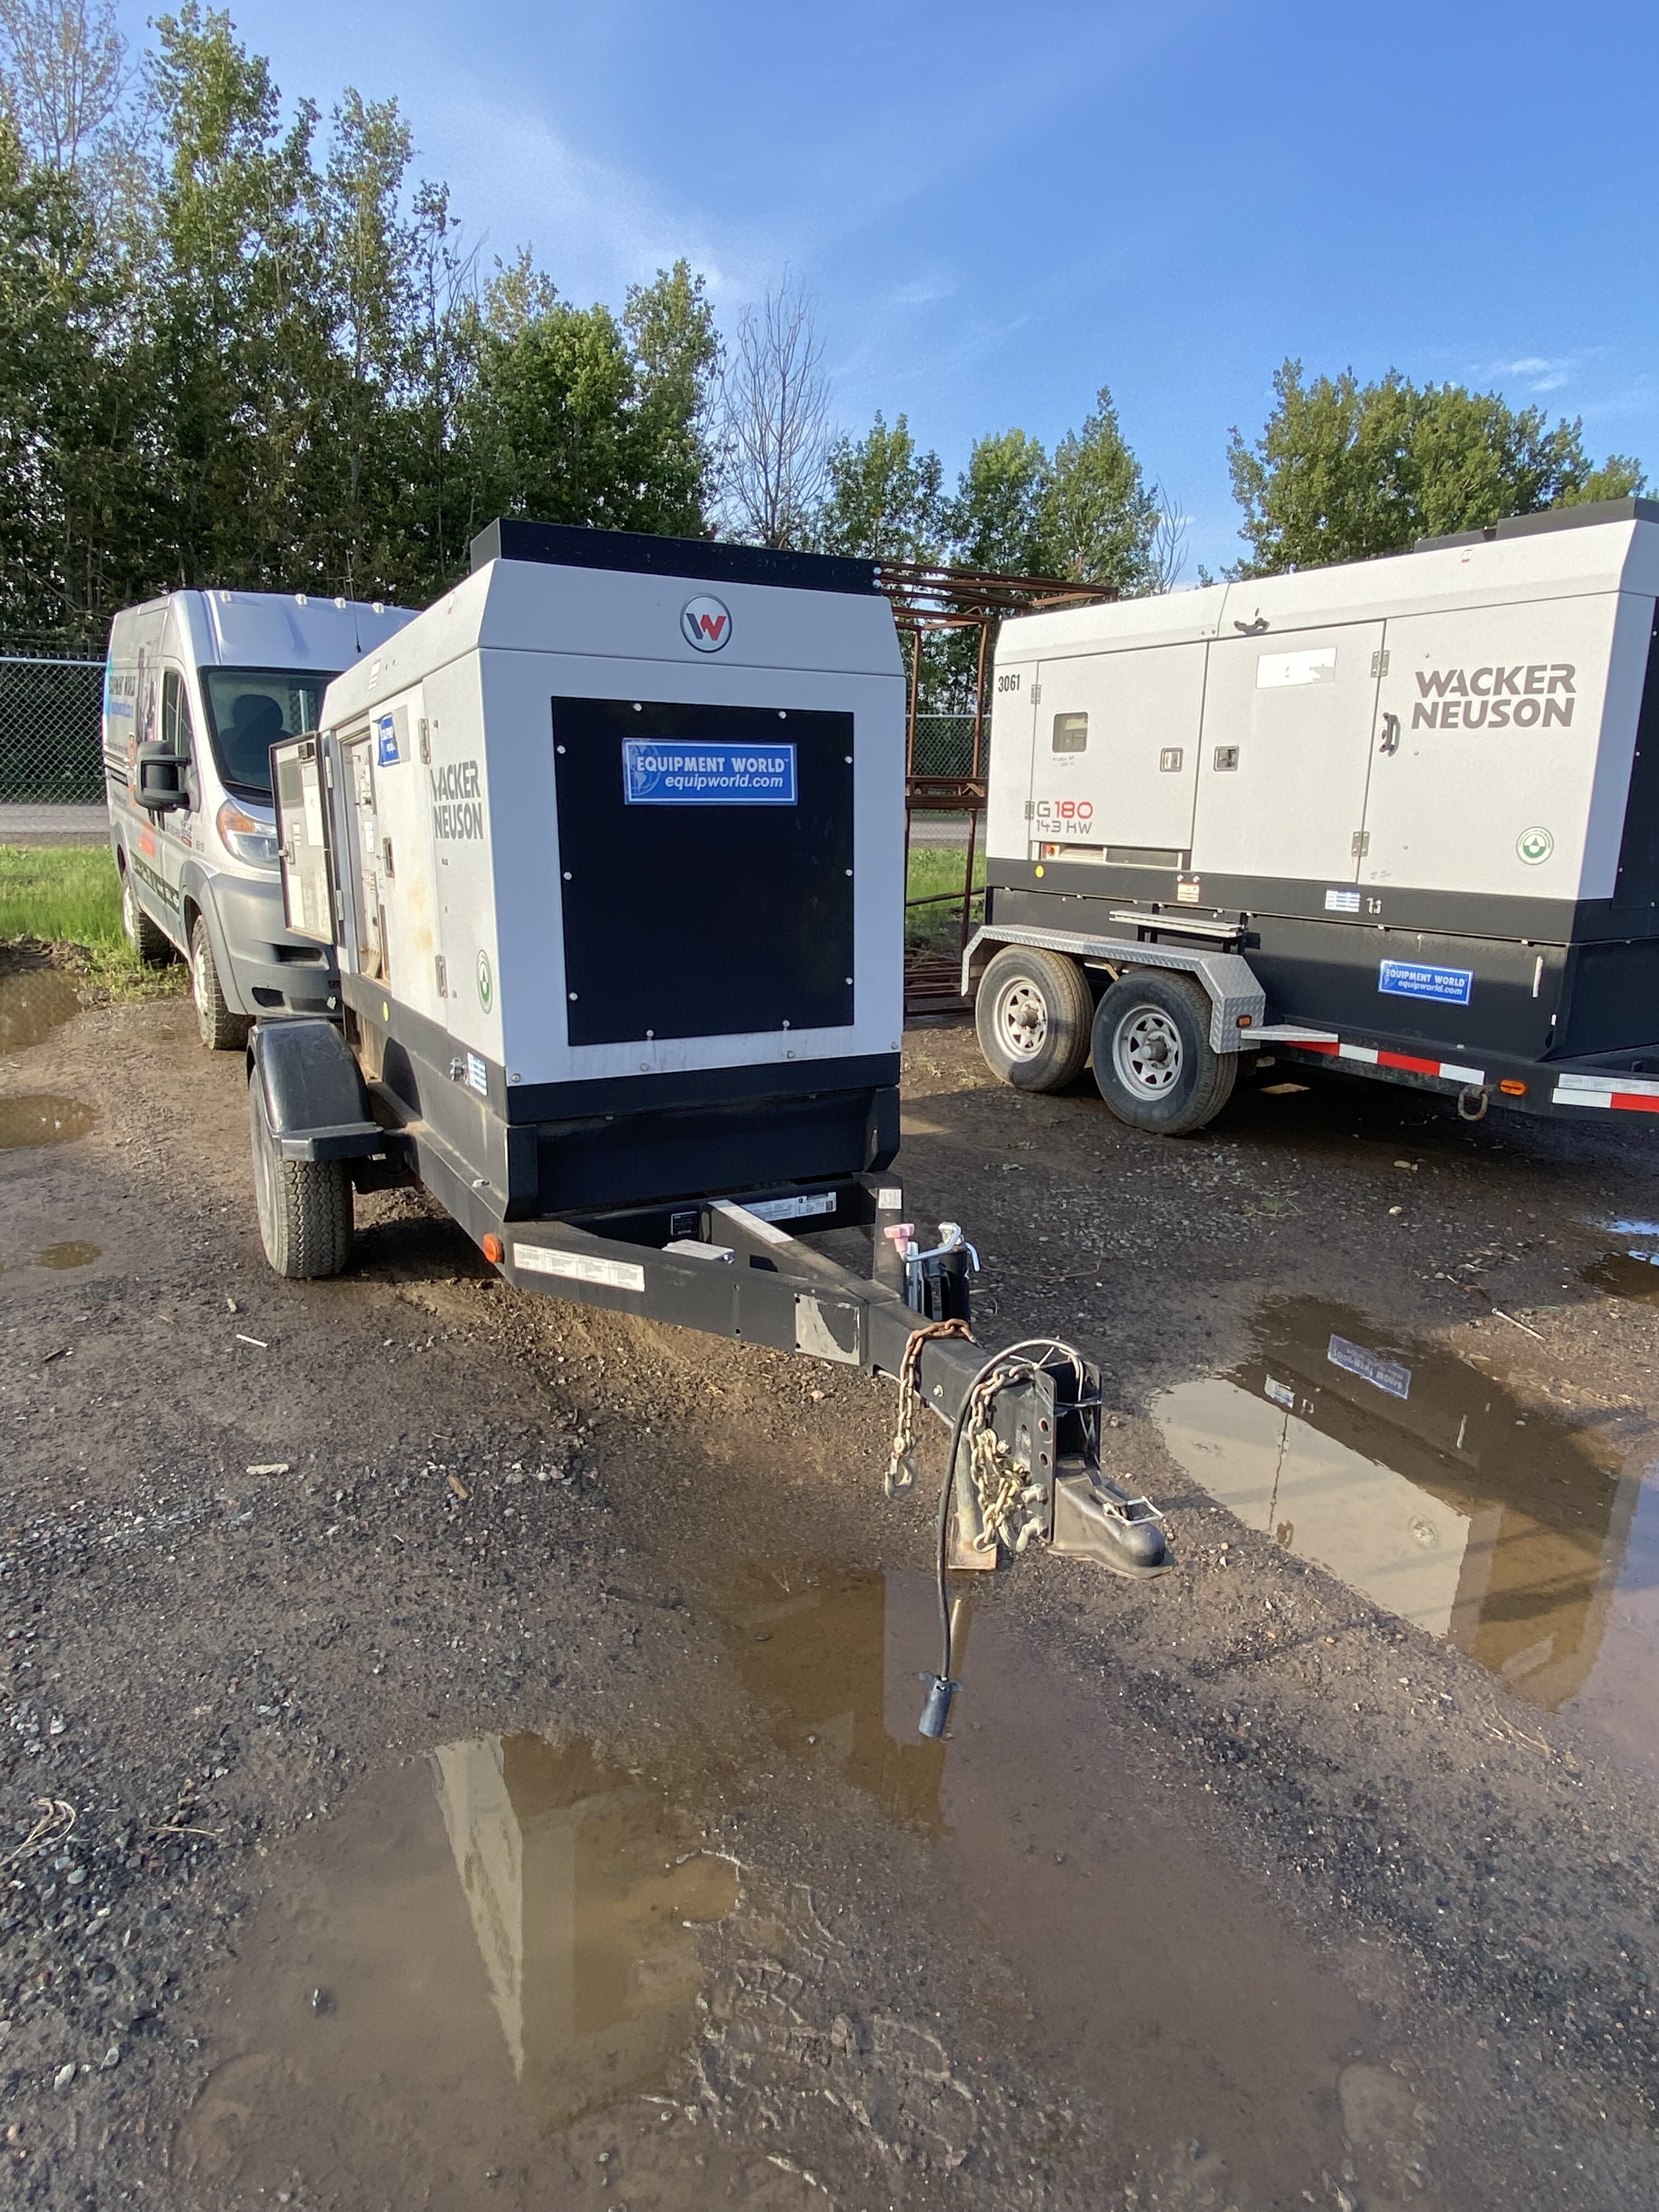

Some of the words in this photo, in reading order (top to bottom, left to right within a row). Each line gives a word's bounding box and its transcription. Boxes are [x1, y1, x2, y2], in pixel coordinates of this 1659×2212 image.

[998, 674, 1020, 692] 3061
[1415, 663, 1576, 698] WACKER
[1411, 698, 1575, 729] NEUSON
[636, 756, 725, 772] EQUIPMENT
[731, 758, 785, 773] WORLD
[665, 773, 783, 791] equipworld.com
[433, 802, 483, 839] NEUSON
[1036, 820, 1062, 833] 143
[1386, 968, 1431, 983] EQUIPMENT
[1434, 974, 1465, 987] WORLD
[1398, 980, 1463, 995] equipworld.com
